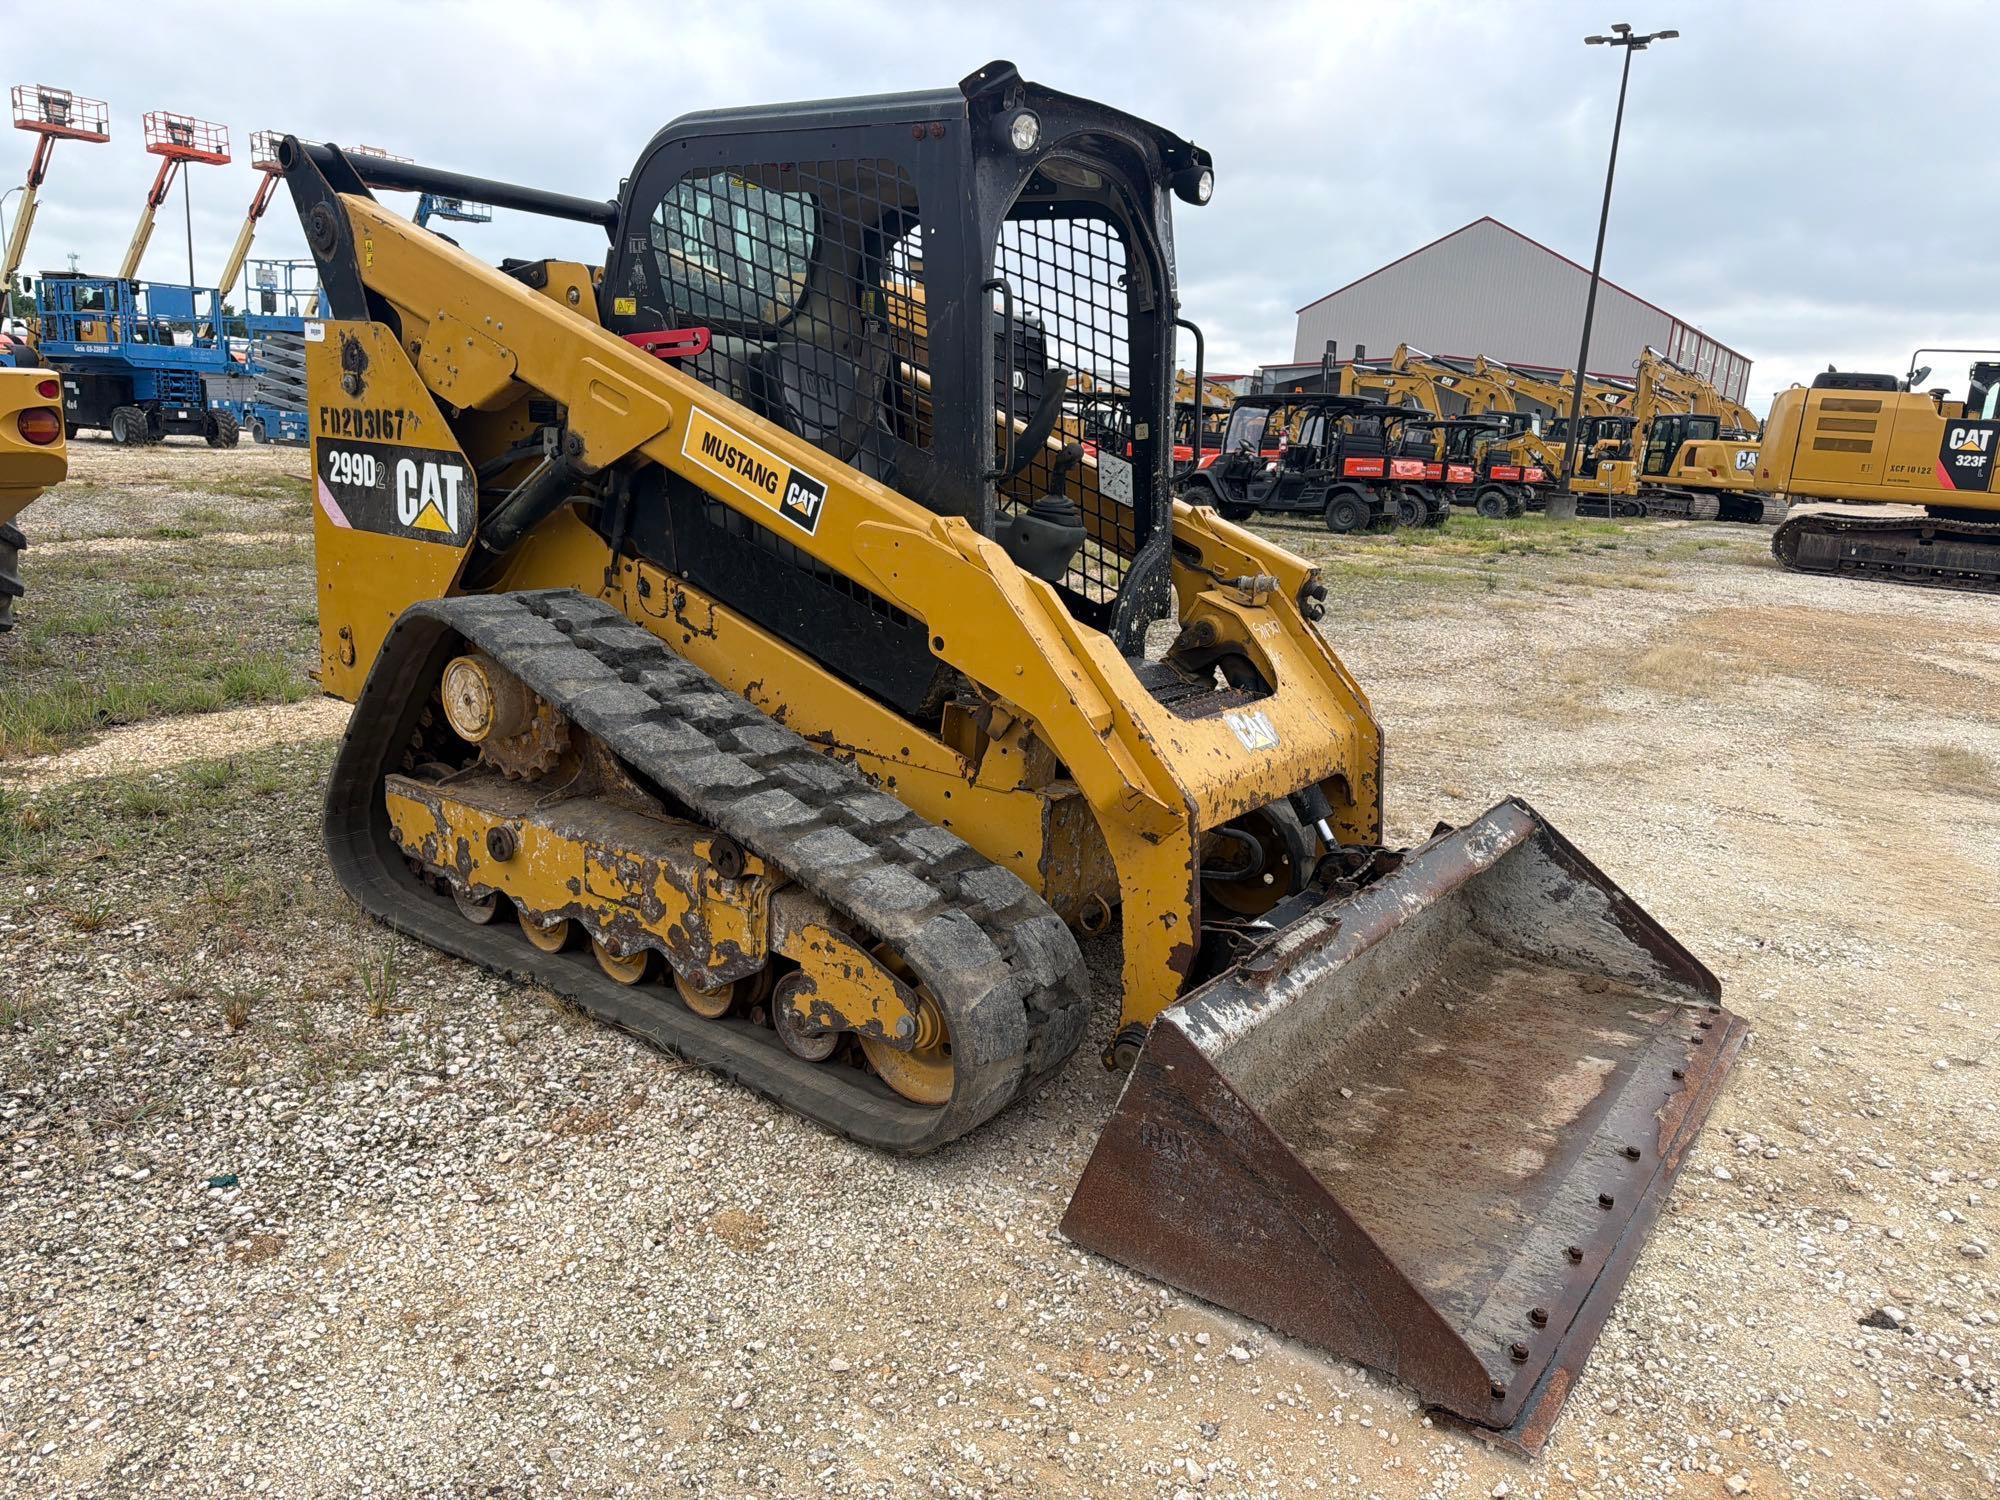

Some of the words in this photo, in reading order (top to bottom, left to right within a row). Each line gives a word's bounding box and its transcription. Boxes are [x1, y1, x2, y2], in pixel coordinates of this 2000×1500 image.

[1441, 376, 1454, 386] CAT
[1604, 393, 1619, 404] CAT
[1949, 427, 1993, 452] CAT
[1602, 463, 1613, 471] CAT
[1955, 454, 1988, 467] 323F
[701, 431, 779, 494] MUSTANG
[786, 482, 819, 518] CAT
[396, 458, 463, 535] CAT
